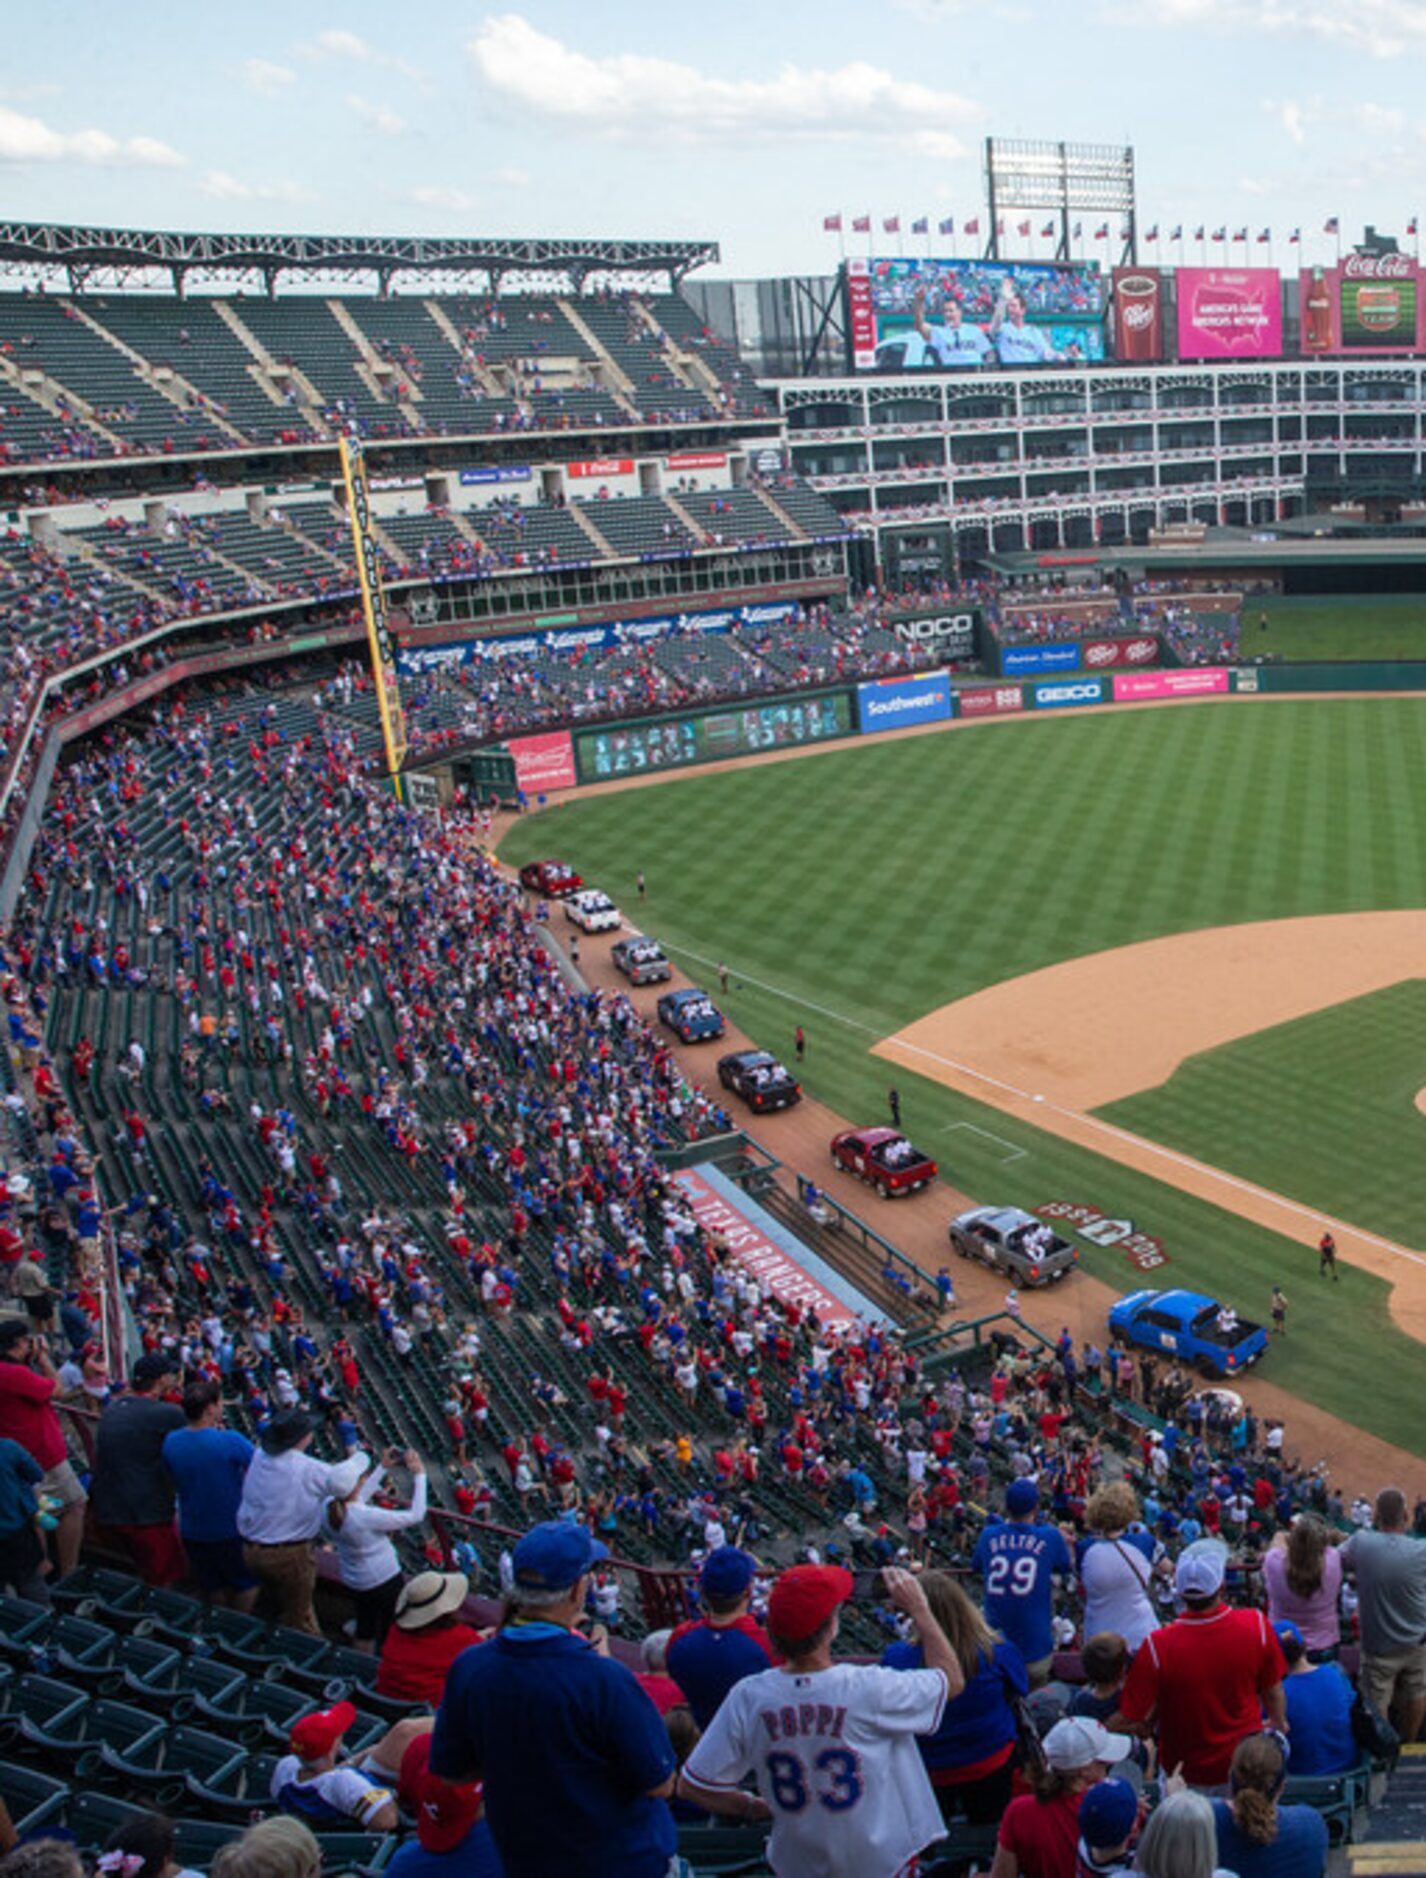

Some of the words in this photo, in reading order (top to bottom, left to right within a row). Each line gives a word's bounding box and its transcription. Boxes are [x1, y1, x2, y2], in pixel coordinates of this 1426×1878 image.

[894, 614, 973, 641] NOCO
[868, 693, 934, 715] Southwest
[1036, 684, 1101, 703] GEICO
[694, 1200, 759, 1248] TEXAS
[742, 1245, 833, 1310] RANGERS
[987, 1555, 1038, 1596] 29
[765, 1746, 865, 1814] 83
